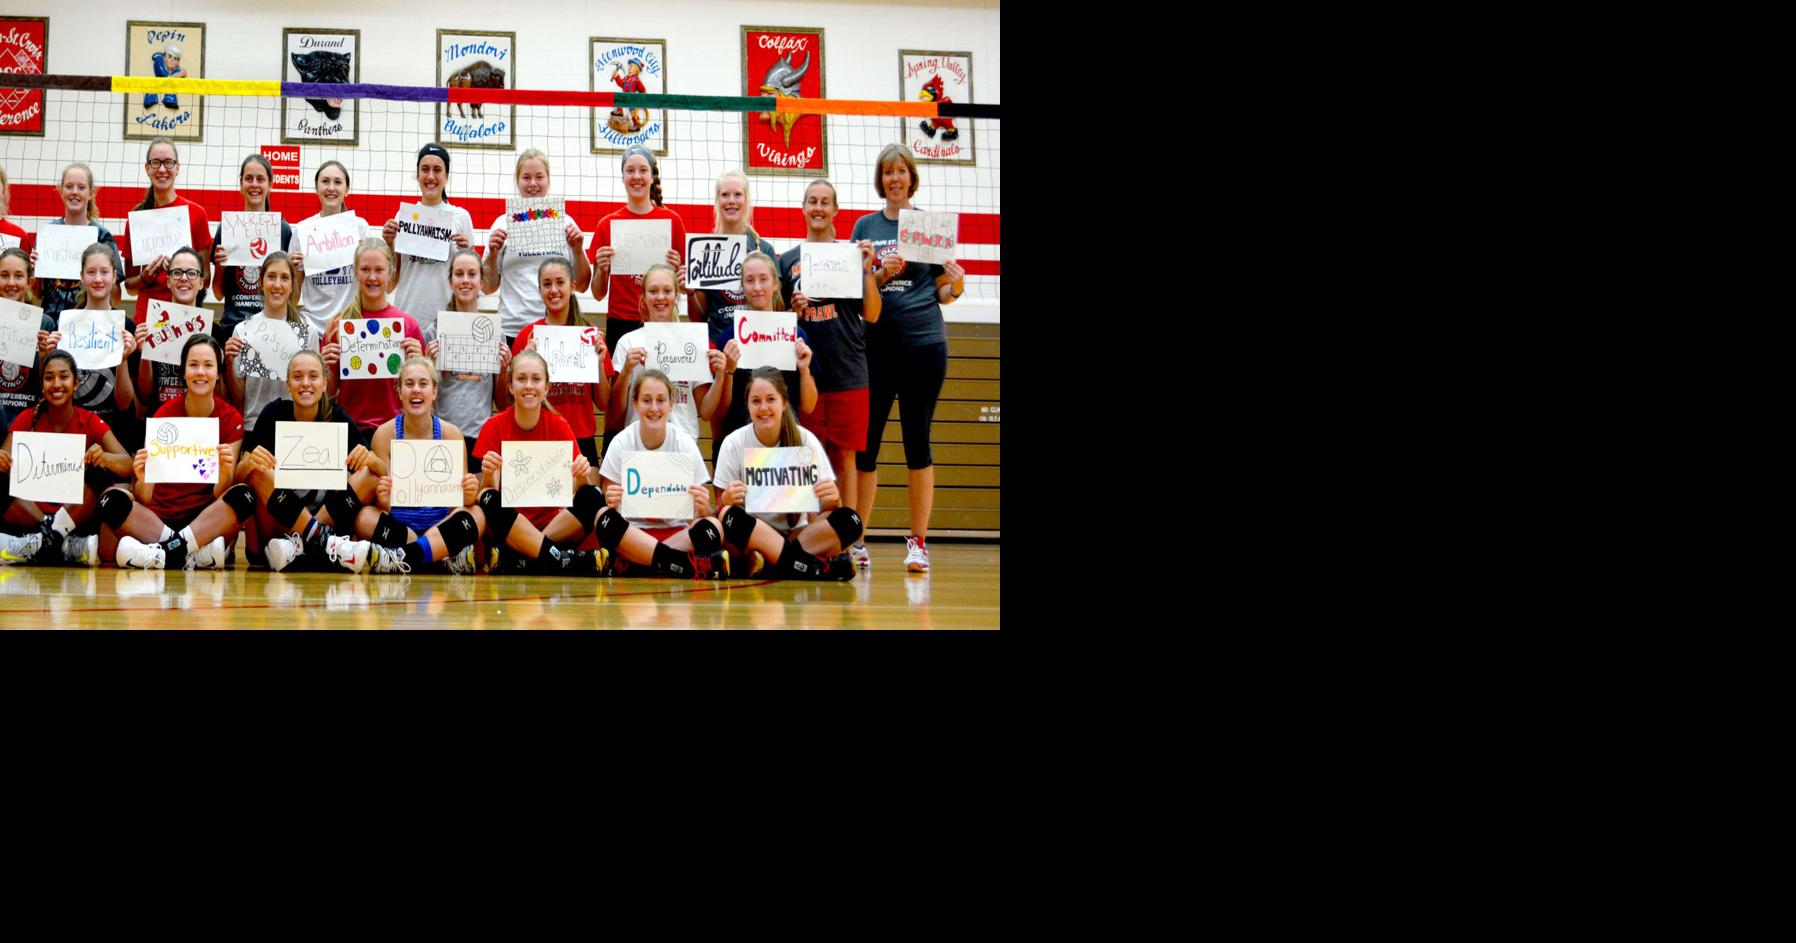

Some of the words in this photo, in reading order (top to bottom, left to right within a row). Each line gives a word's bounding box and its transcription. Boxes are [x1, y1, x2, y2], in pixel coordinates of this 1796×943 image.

[147, 29, 185, 43] Pepin
[299, 36, 345, 50] Durand
[758, 35, 808, 54] Colfax
[445, 41, 507, 62] Mondovi
[905, 57, 938, 79] Spring
[941, 56, 966, 85] Valley
[0, 101, 40, 126] erence
[136, 110, 191, 131] Lakers
[263, 151, 298, 162] HOME
[757, 143, 816, 169] Vikings
[913, 139, 963, 158] Cardinals
[306, 229, 355, 257] Ambition
[311, 274, 353, 286] VOLLEYBALL
[68, 322, 118, 350] Resilient
[738, 316, 796, 345] Committed
[340, 336, 401, 354] Determination
[149, 439, 215, 458] Supportive
[281, 426, 344, 468] Zeal
[745, 464, 818, 487] MOTIVATING
